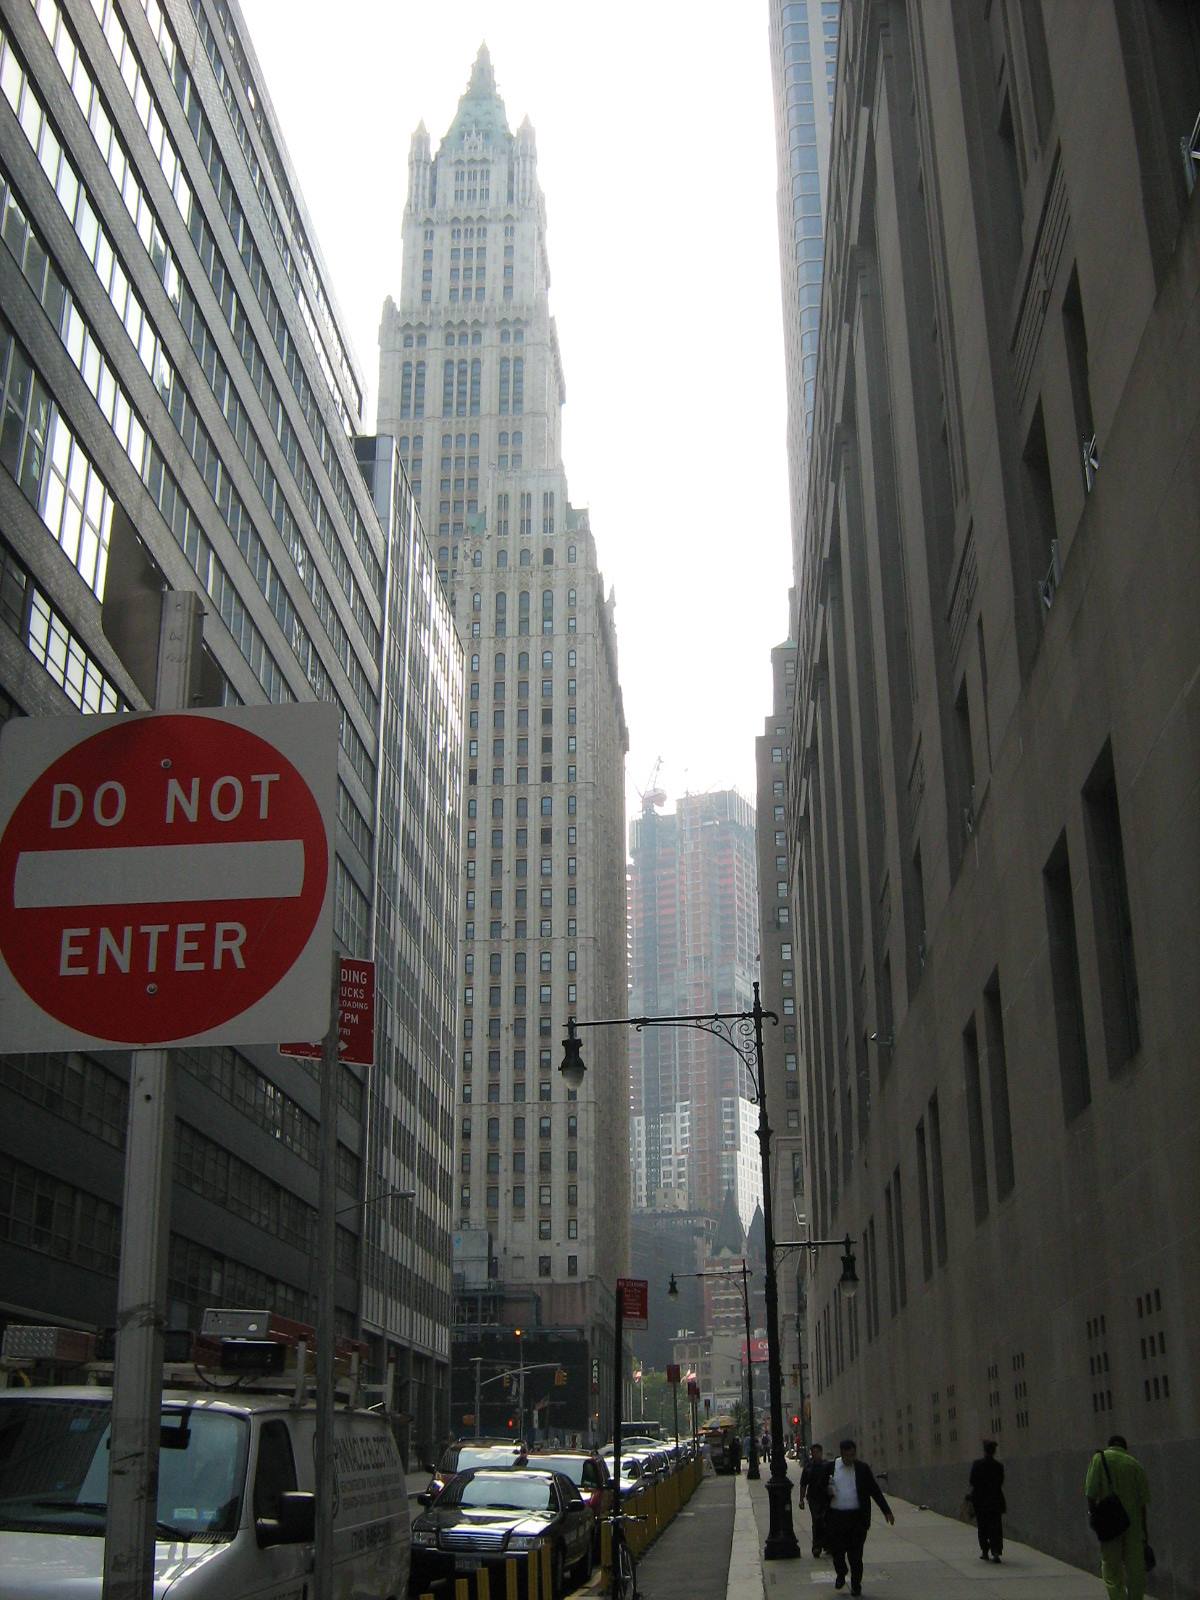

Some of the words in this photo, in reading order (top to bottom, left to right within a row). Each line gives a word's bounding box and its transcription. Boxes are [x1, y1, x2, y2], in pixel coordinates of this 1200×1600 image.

[50, 780, 127, 829] DO
[165, 773, 281, 824] NOT
[59, 921, 248, 977] ENTER
[341, 968, 367, 985] DING
[341, 986, 365, 1000] UCKS
